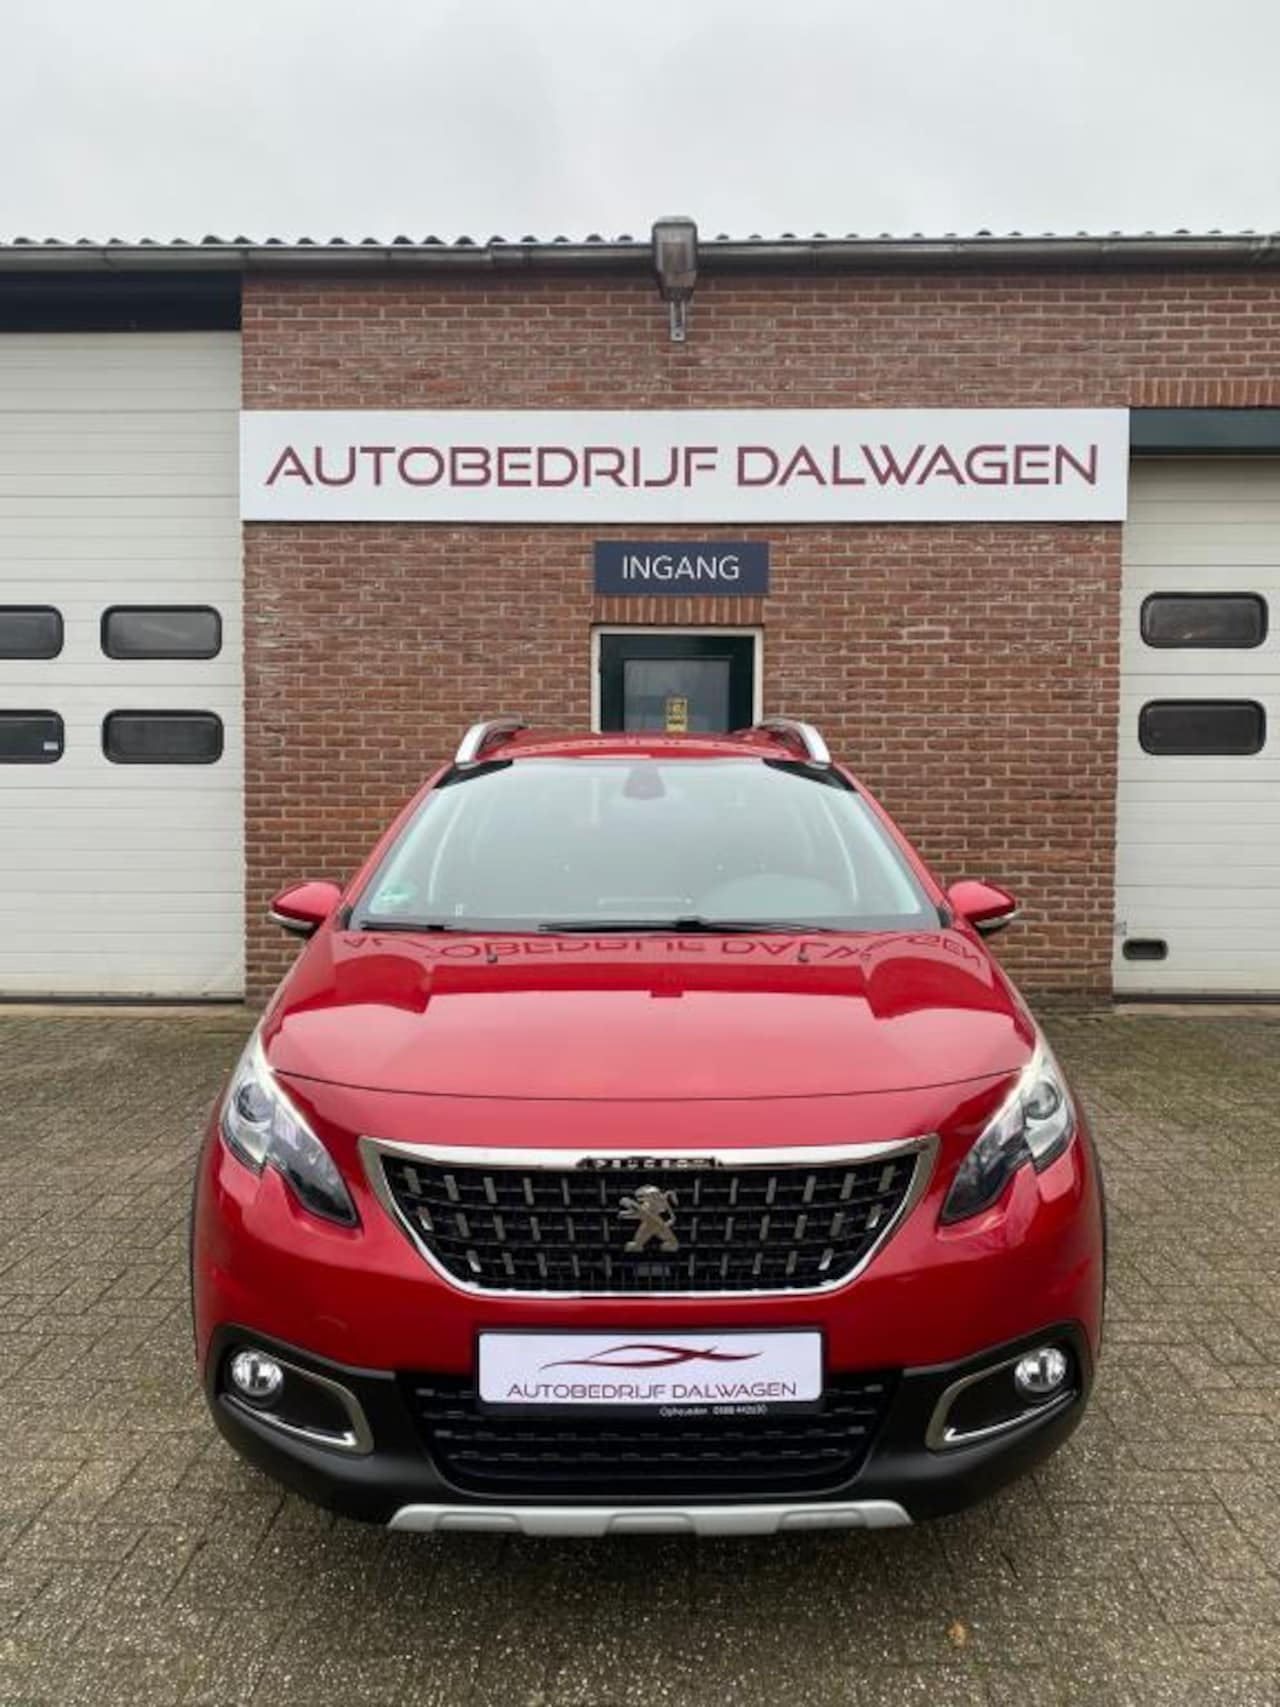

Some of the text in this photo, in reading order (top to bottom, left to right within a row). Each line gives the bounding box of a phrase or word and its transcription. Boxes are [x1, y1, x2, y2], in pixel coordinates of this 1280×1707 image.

[265, 444, 1097, 488] AUTOBEDRIJF DALWAGEN
[621, 554, 741, 581] INGANG
[506, 1381, 798, 1399] AUTOBEDRIJF DALWAGEN
